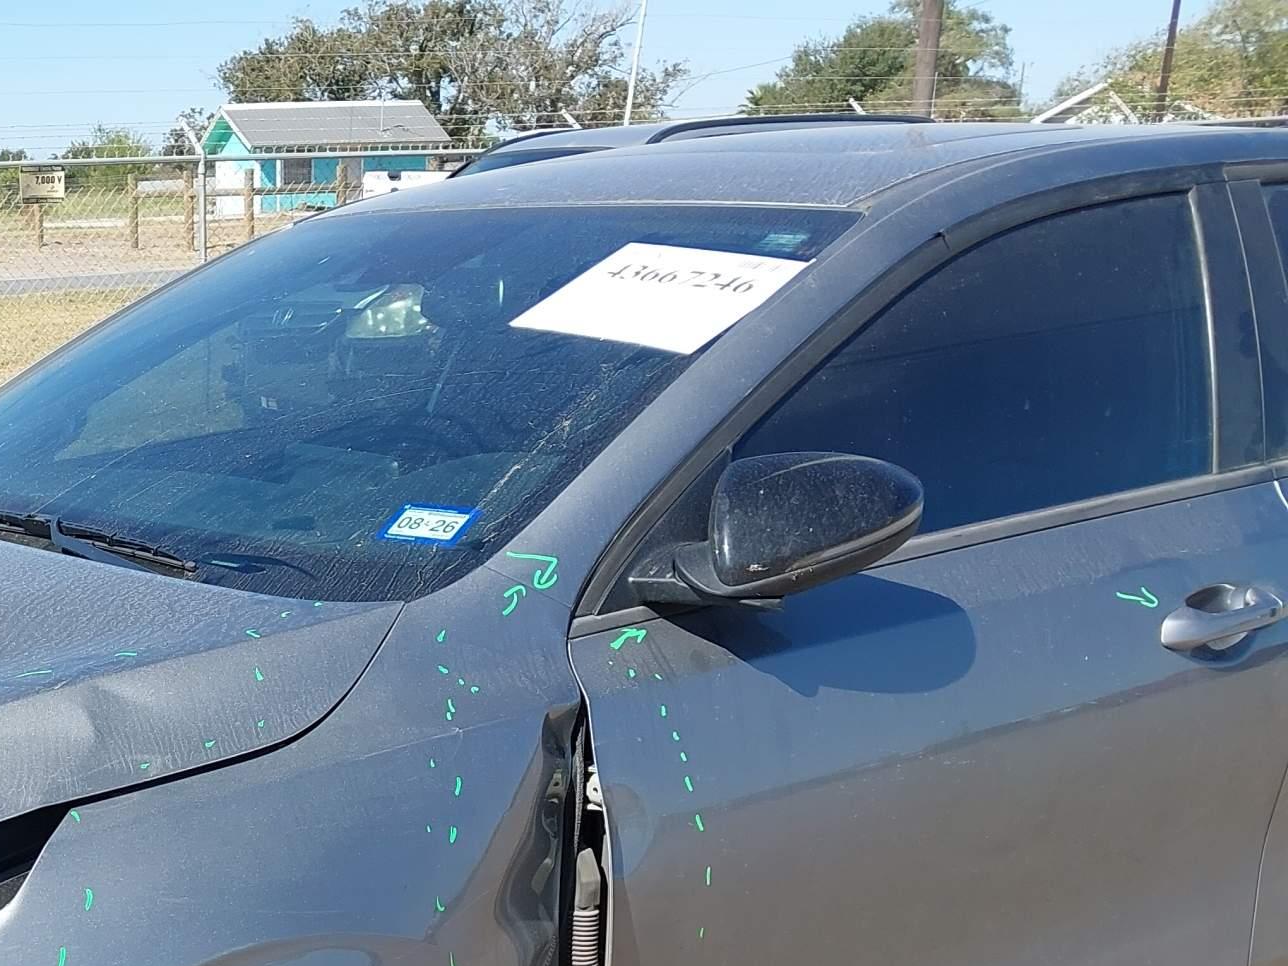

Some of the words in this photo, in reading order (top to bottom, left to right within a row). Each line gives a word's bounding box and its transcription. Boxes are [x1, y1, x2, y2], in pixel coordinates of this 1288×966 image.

[35, 176, 55, 185] 7,000
[57, 175, 62, 185] V
[608, 263, 755, 293] 43667246
[397, 516, 425, 530] 08
[429, 519, 459, 534] 26
